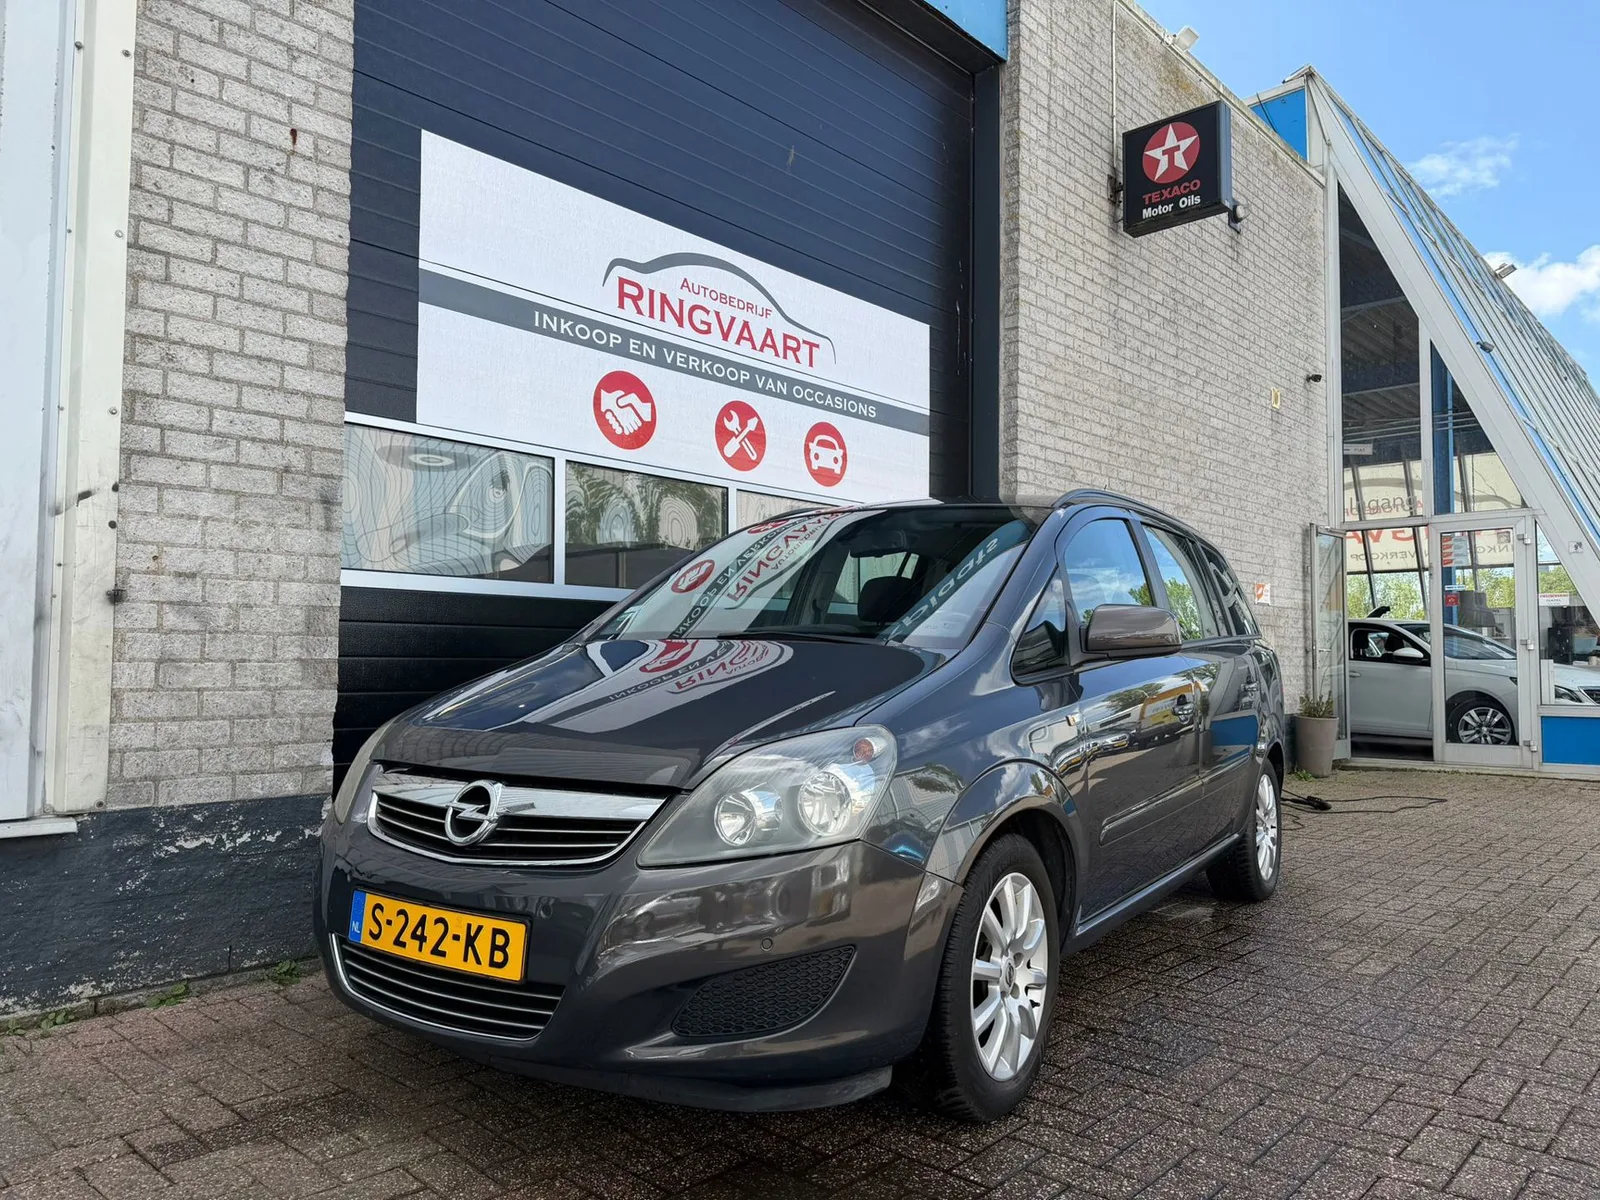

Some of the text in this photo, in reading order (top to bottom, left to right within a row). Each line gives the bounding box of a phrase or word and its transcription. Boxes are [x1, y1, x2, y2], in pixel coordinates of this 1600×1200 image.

[1142, 195, 1201, 219] Motor Oils
[1143, 180, 1201, 205] TEXACO
[680, 277, 773, 319] AUTOBEDRIJF
[617, 276, 820, 368] RINGVAART
[534, 310, 877, 418] INKOOP EN VERKOOP VAN OCCASIONS
[351, 920, 361, 934] NL
[368, 903, 510, 969] S-242-KB
